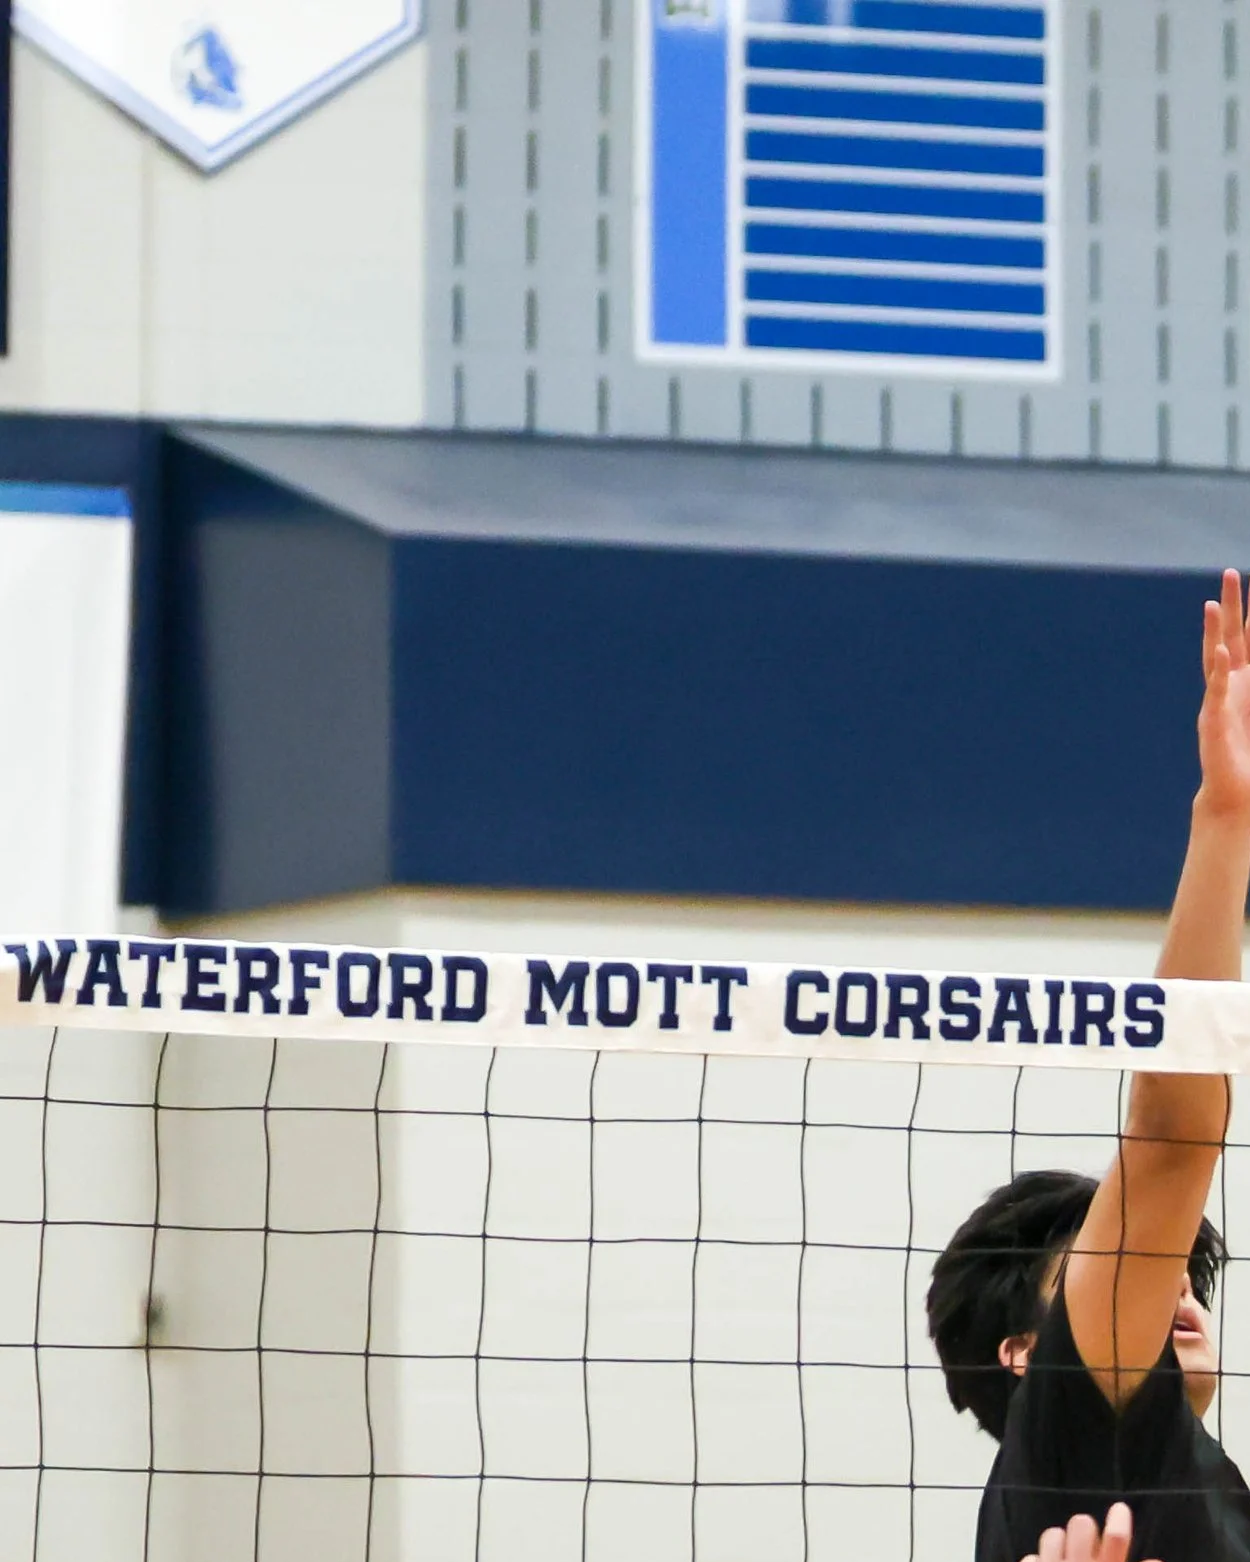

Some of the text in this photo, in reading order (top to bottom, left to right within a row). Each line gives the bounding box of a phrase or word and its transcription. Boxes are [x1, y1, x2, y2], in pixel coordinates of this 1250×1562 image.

[6, 940, 1166, 1048] WATERFORD MOTT CORSAIRS
